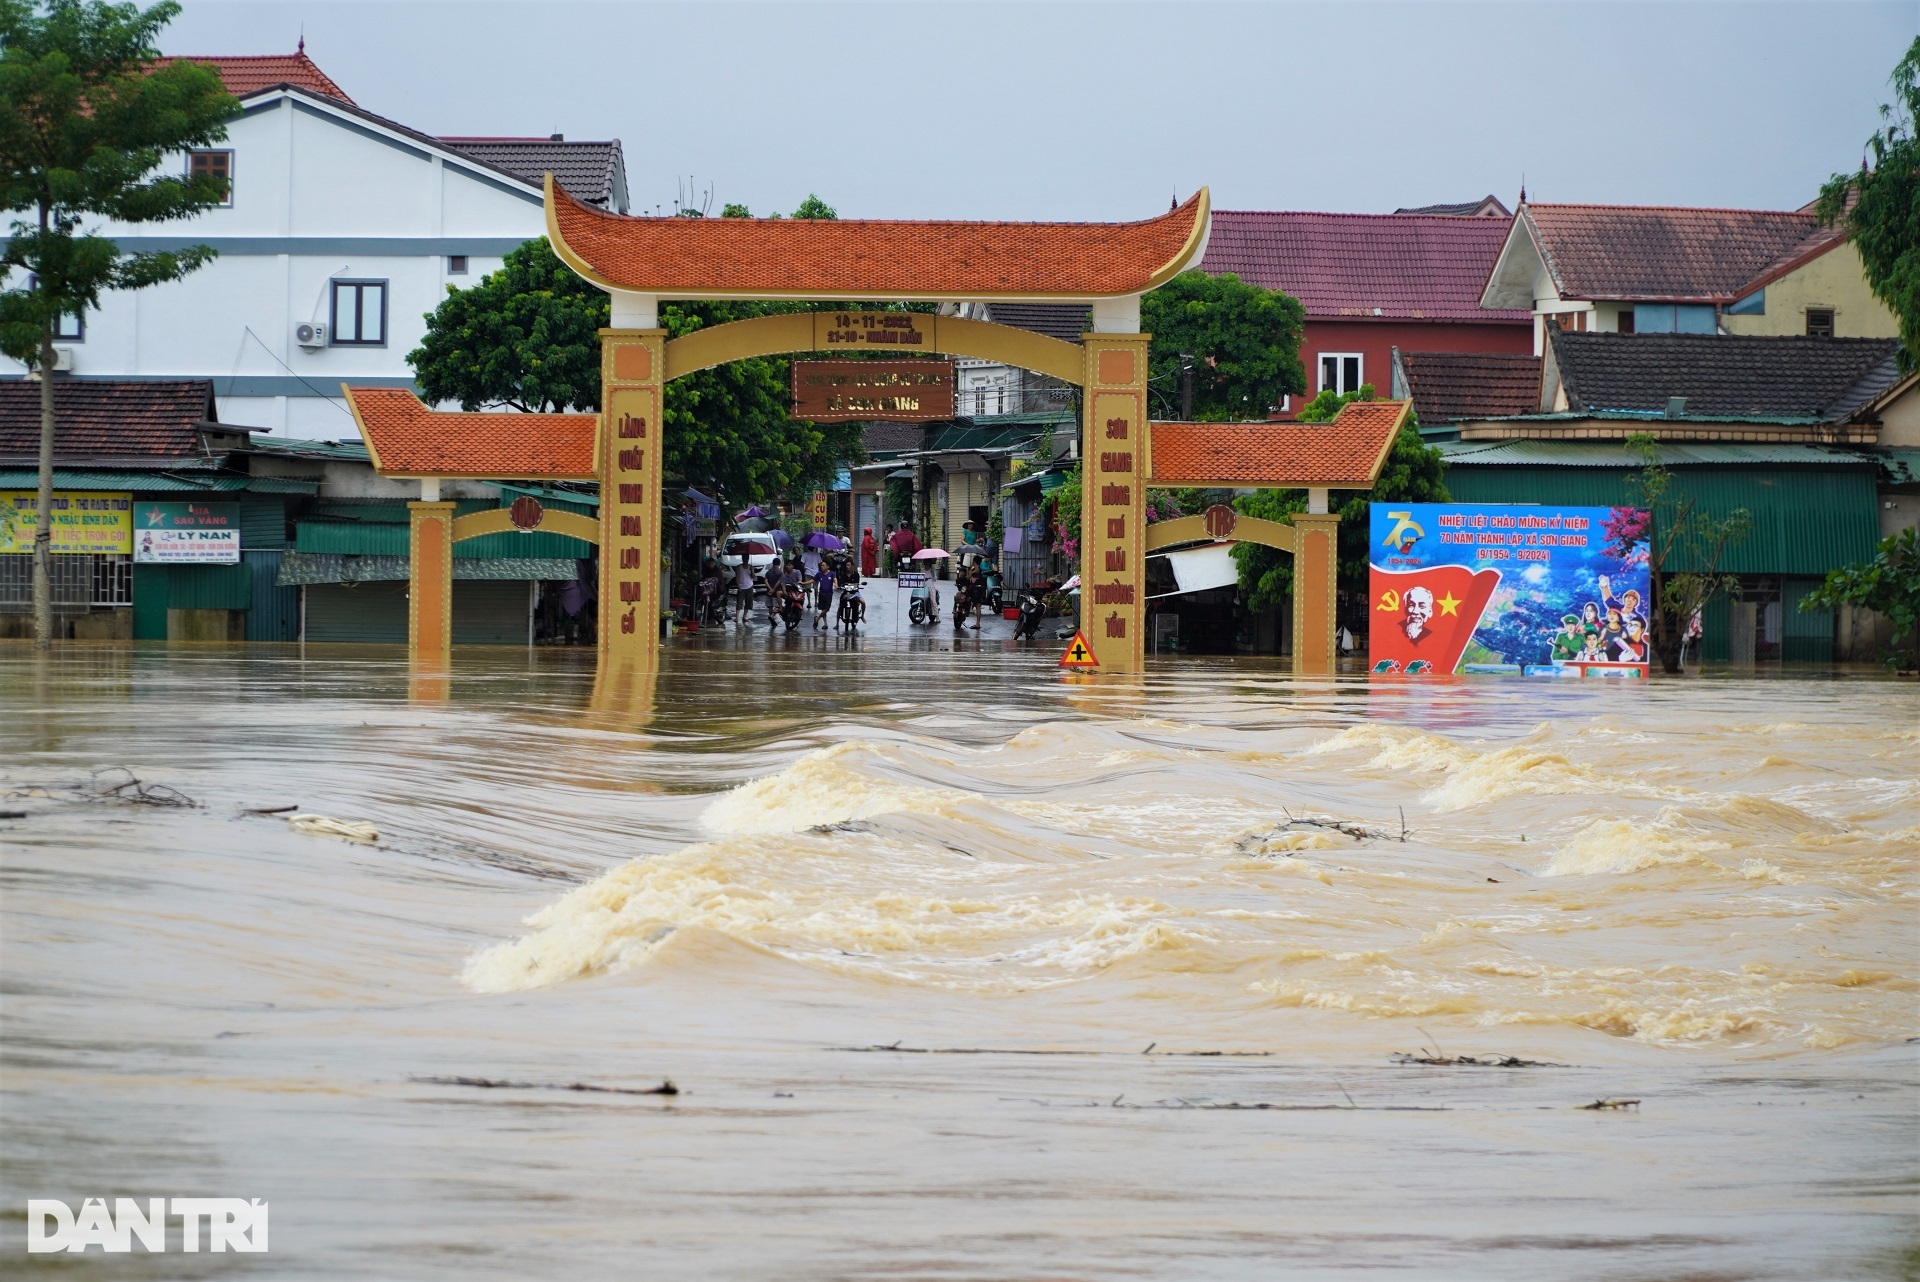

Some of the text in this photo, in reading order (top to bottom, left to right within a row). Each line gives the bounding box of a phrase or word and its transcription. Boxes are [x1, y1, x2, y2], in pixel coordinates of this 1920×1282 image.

[836, 315, 850, 328] 14
[862, 315, 874, 328] 11
[828, 330, 857, 343] 21-10
[879, 396, 919, 410] GIANG
[618, 413, 646, 438] LÀNG
[1106, 417, 1128, 440] SƠN
[619, 446, 644, 473] QUÁT
[1100, 452, 1132, 472] GIANG
[619, 484, 642, 504] VINH
[1102, 482, 1130, 506] HÙNG
[58, 513, 79, 527] NHẬU
[103, 513, 119, 525] DÂN
[198, 515, 227, 525] VÀNG
[620, 516, 641, 536] HOA
[1107, 514, 1125, 538] KHÍ
[1439, 513, 1588, 532] NHIỆT LIỆT CHÀO MỪNG KỶ NIỆM
[1440, 531, 1587, 547] 70 NĂM THÀNH LẬP XÃ SƠN GIANG
[620, 546, 641, 569] LƯU
[1105, 546, 1126, 572] MÃI
[1477, 549, 1509, 561] (9/1954
[1518, 550, 1550, 561] 9/2024)
[620, 581, 640, 605] VẠN
[1094, 578, 1134, 605] TRƯỜNG
